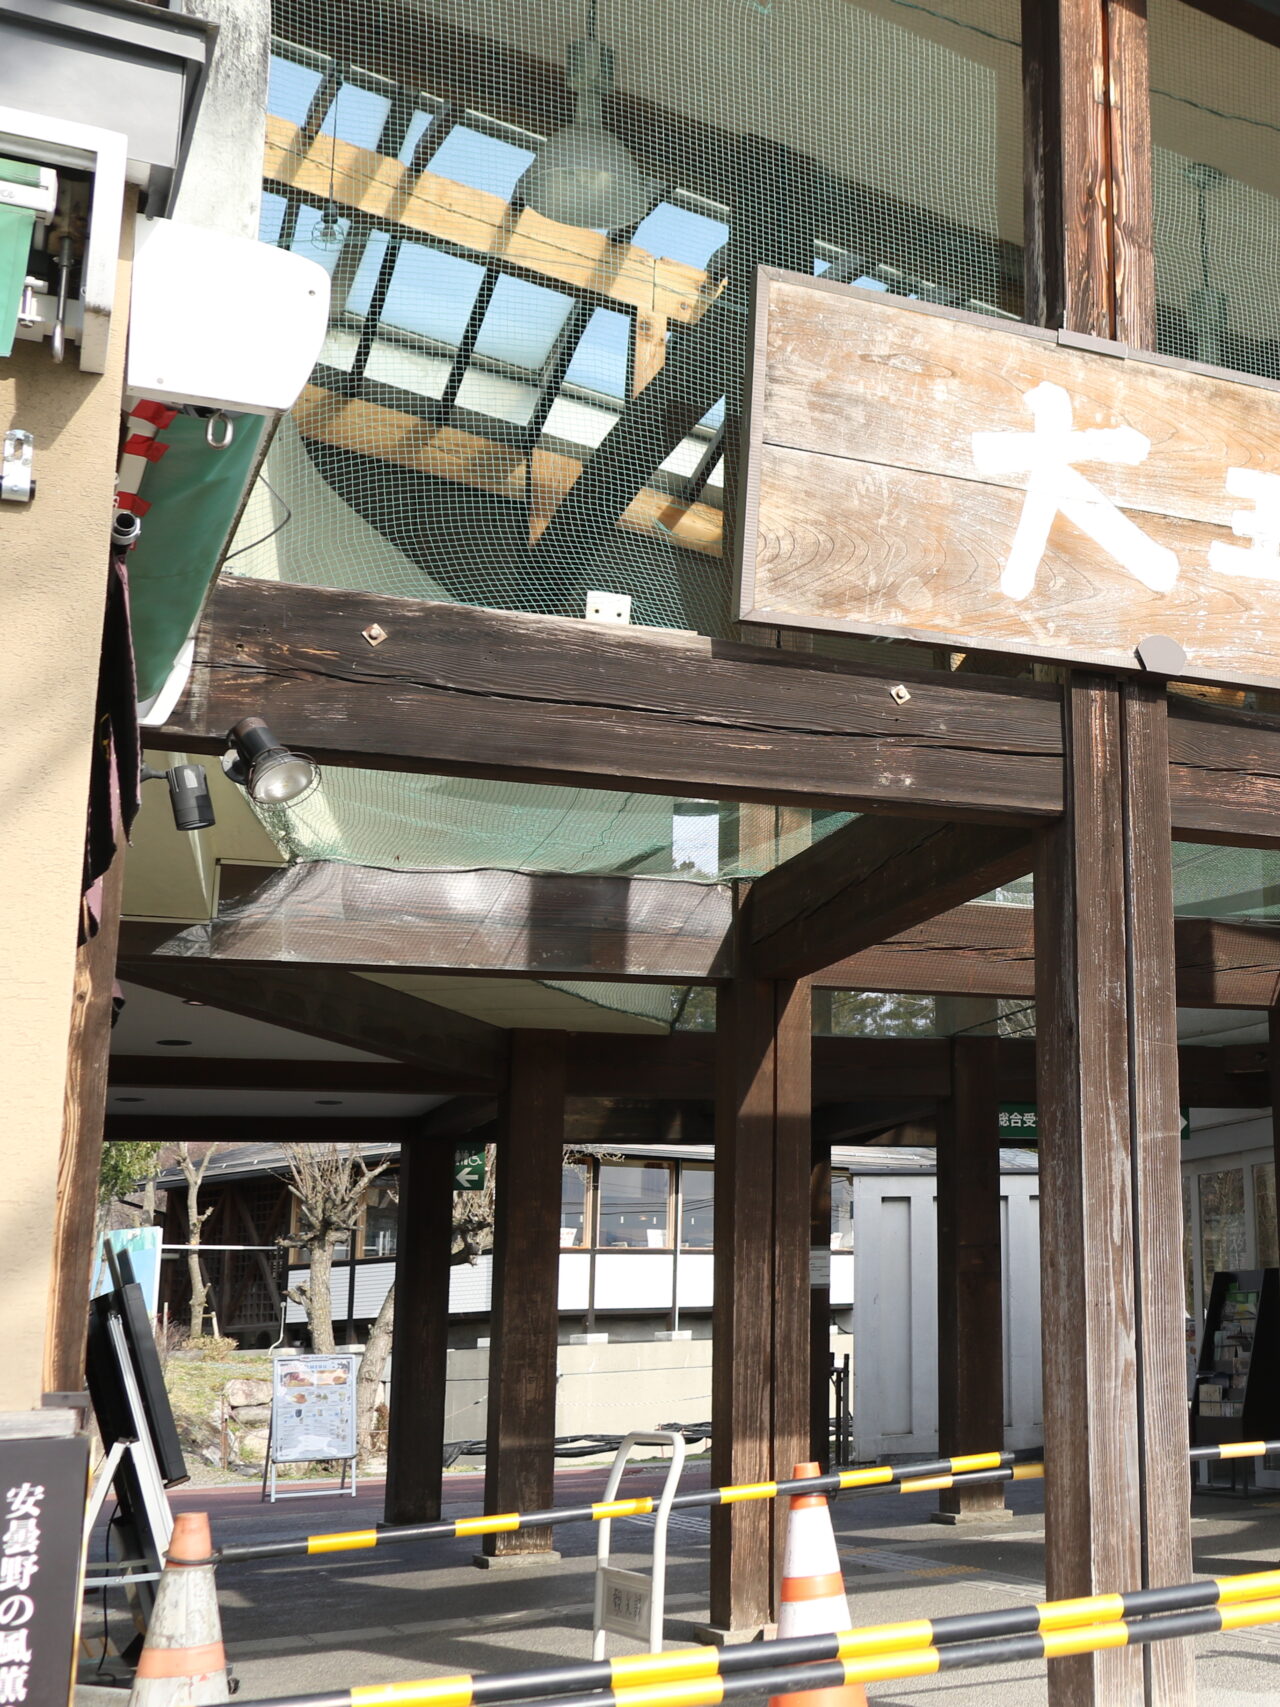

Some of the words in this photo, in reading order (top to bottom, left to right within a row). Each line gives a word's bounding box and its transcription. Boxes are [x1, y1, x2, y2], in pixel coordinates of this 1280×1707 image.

[998, 1111, 1039, 1128] 総合受
[0, 1482, 46, 1707] 安曇野の風薫
